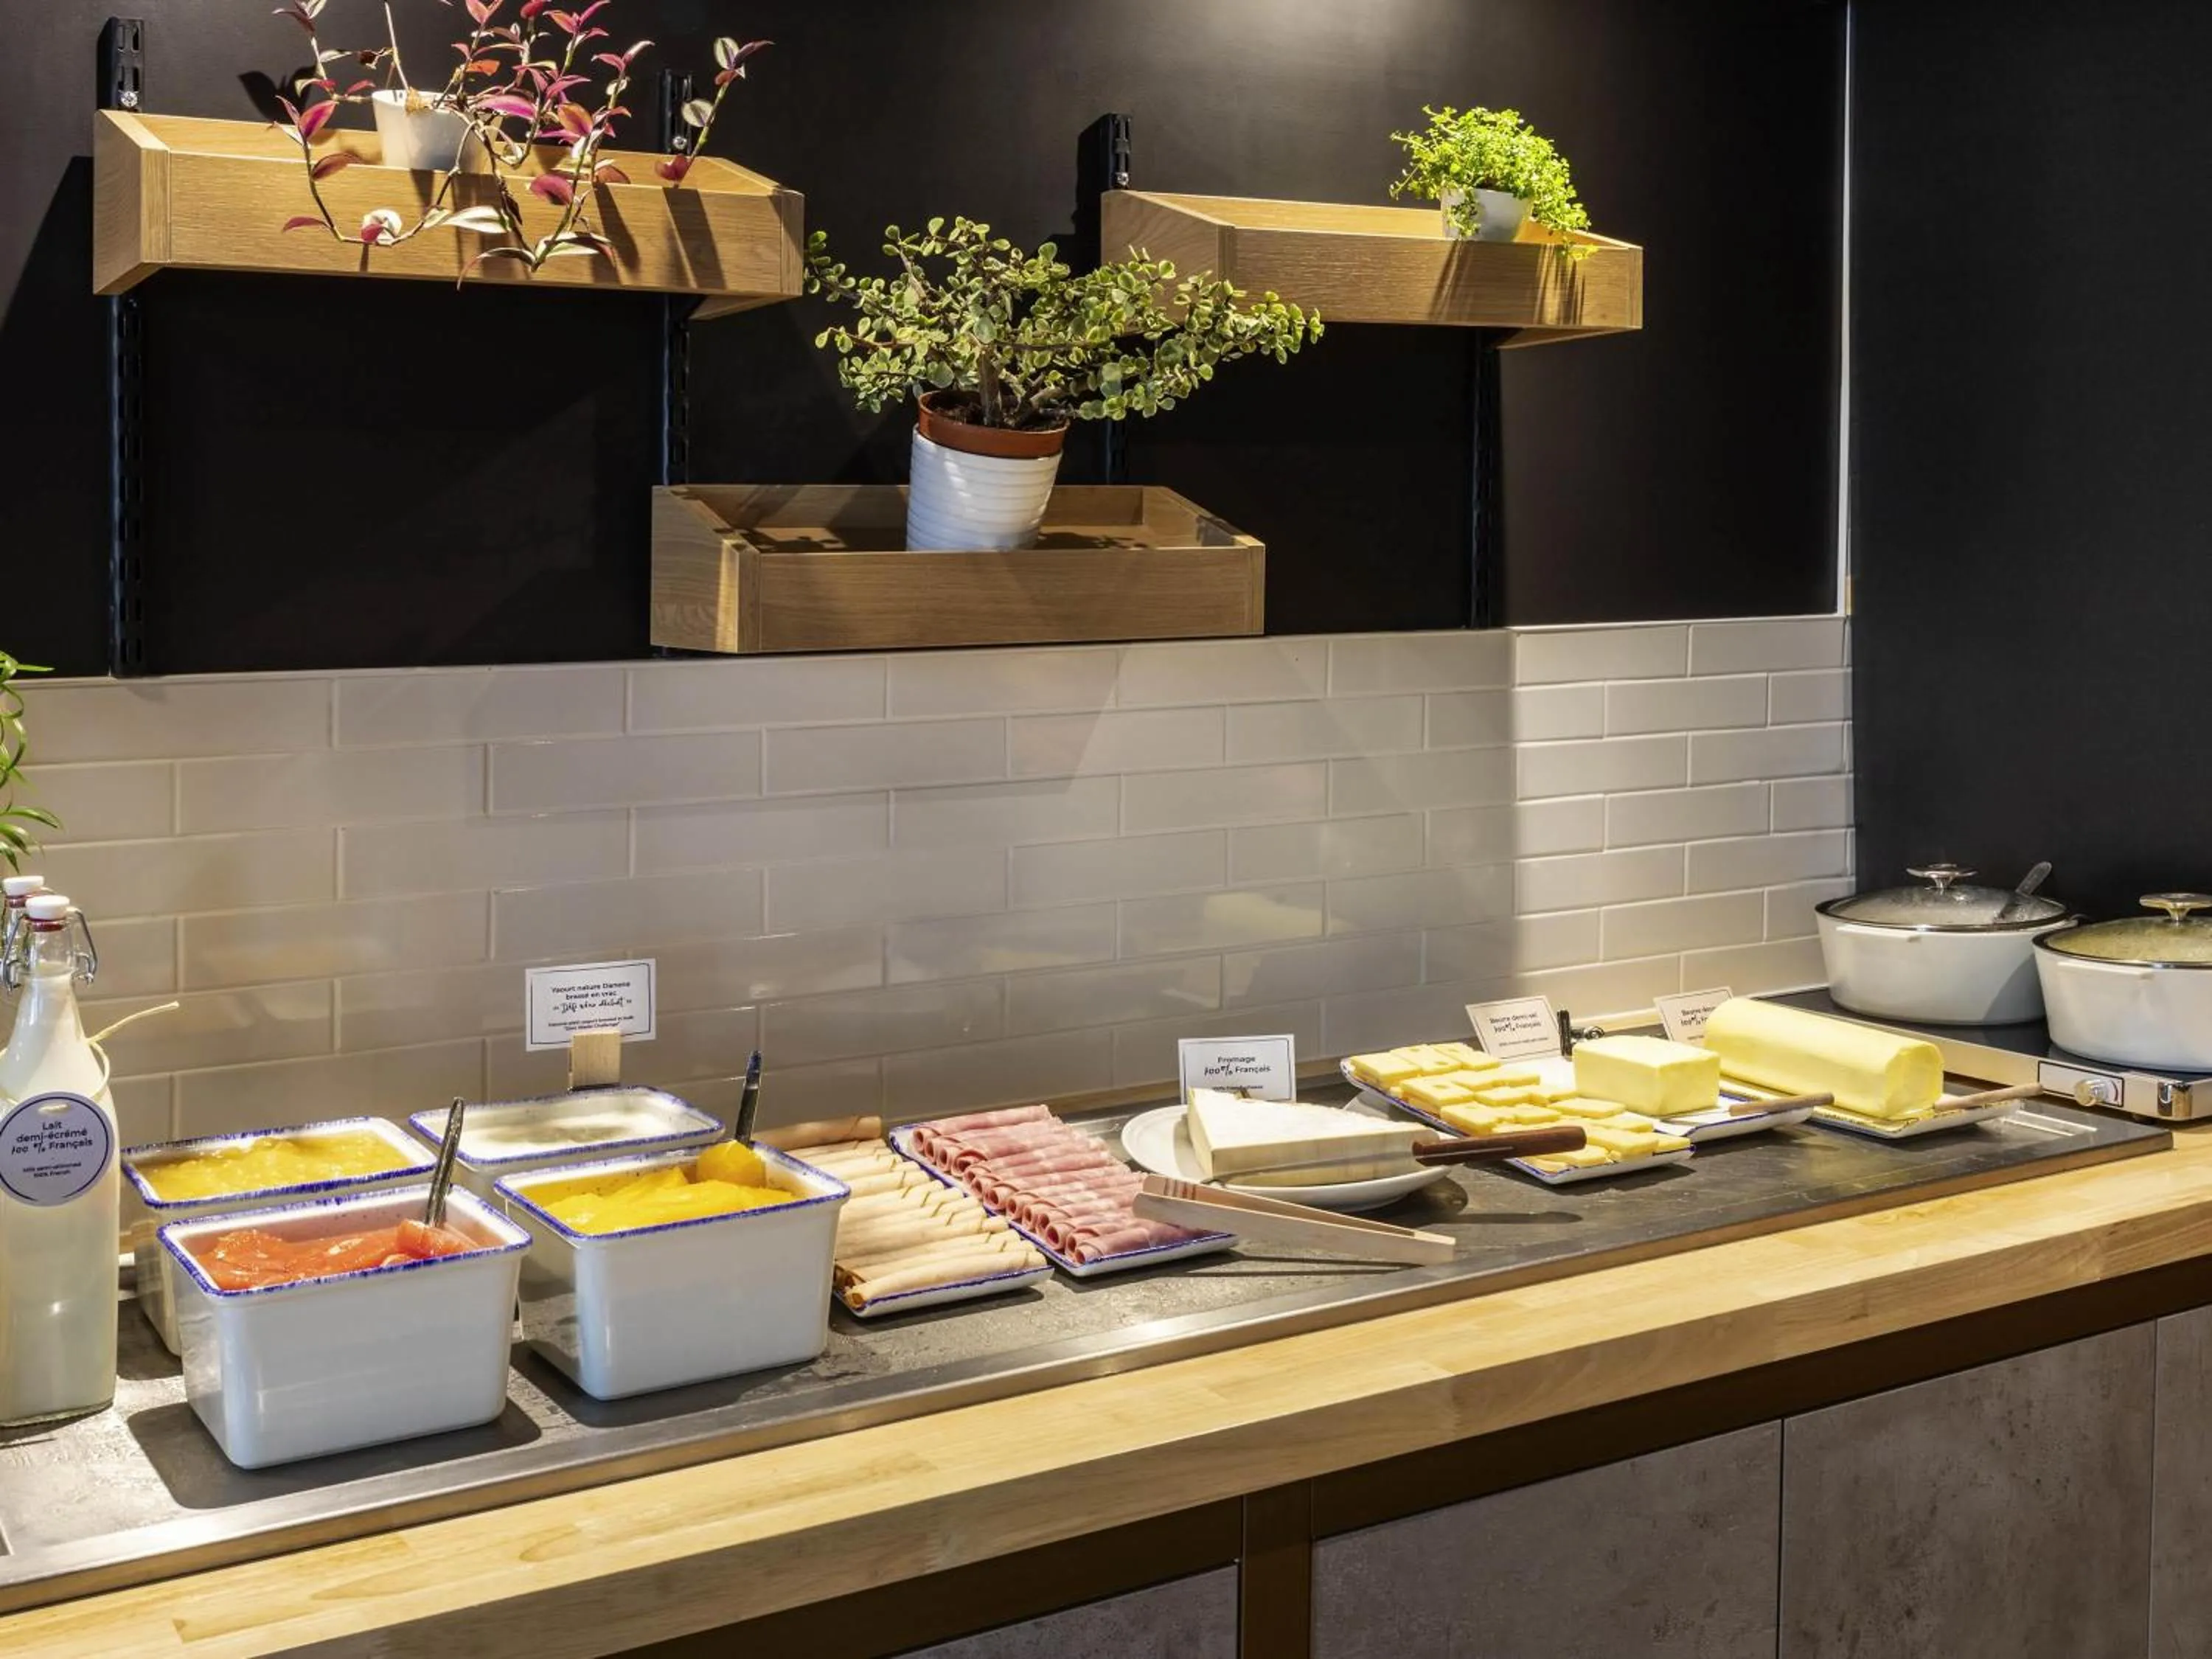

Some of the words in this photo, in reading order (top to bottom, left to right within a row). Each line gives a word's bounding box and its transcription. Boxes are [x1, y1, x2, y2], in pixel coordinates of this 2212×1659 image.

[1204, 1062, 1234, 1077] 100%
[1235, 1065, 1271, 1074] Français
[42, 1121, 62, 1130] Lait
[49, 1138, 93, 1150] Français
